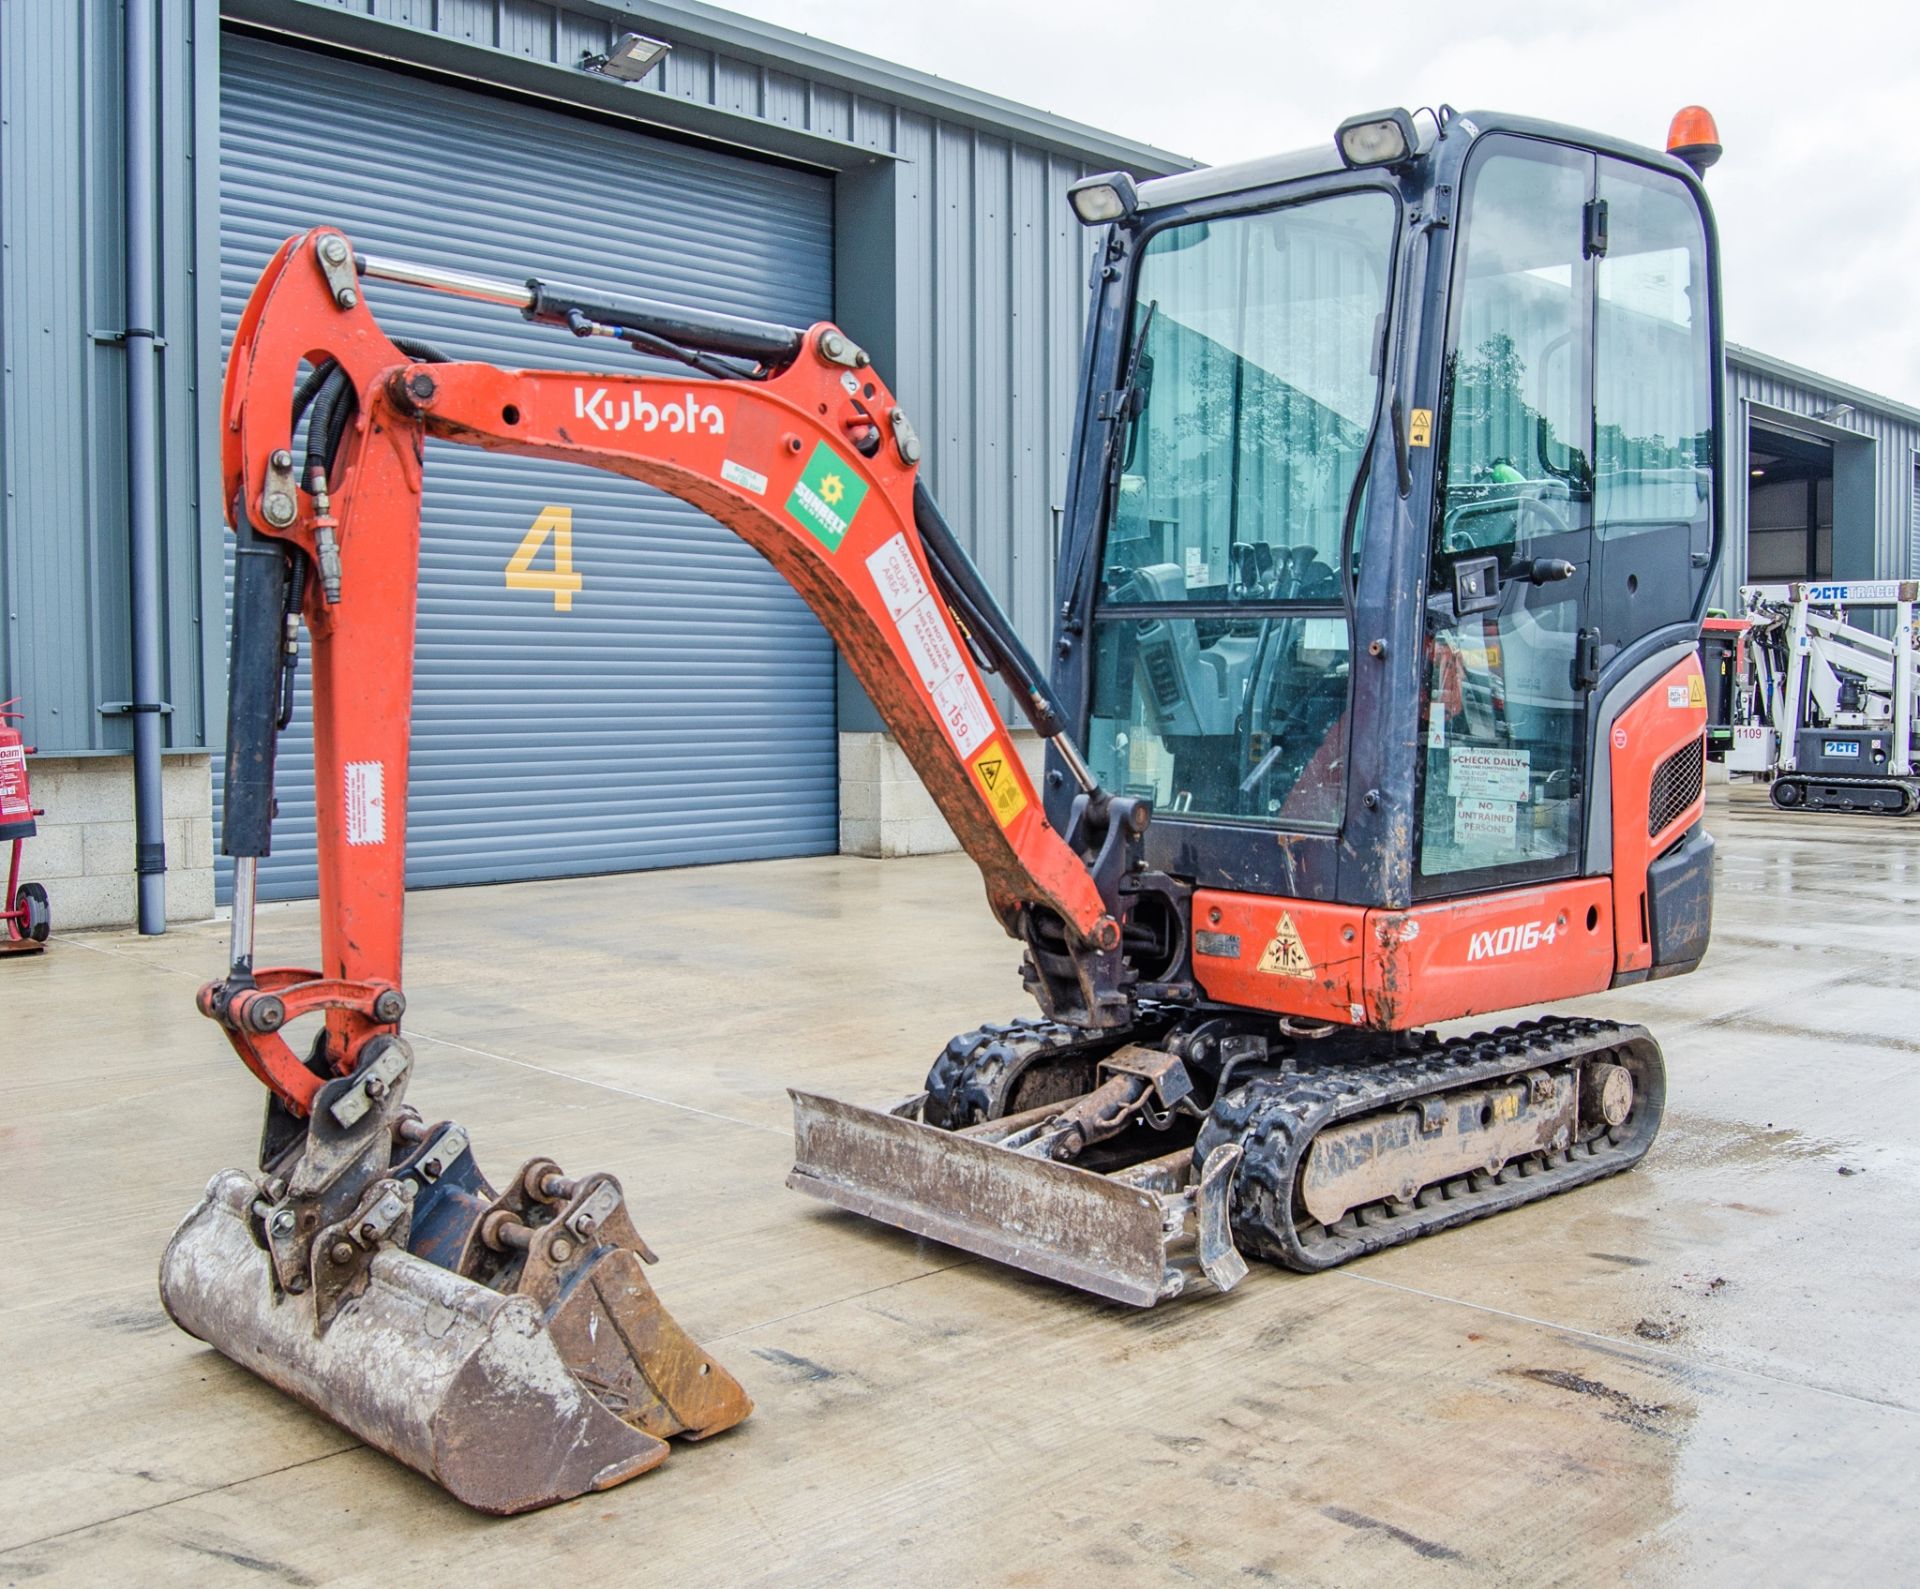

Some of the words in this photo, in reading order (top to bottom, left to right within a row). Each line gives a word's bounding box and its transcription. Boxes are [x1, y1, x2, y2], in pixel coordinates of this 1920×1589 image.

[574, 387, 725, 435] Kubota
[794, 481, 848, 535] SUNBELT
[505, 505, 582, 611] 4
[899, 545, 921, 587] DANGER
[882, 567, 900, 598] AREA
[889, 556, 911, 594] CRUSH
[1822, 586, 1848, 600] CTE
[1848, 584, 1900, 599] TRACC
[915, 606, 927, 627] THIS
[925, 626, 950, 674] EXCAVATOR
[926, 611, 935, 625] DO
[932, 625, 944, 642] NOT
[942, 643, 952, 658] USE
[923, 642, 940, 669] CRANE
[948, 704, 969, 737] 159
[1736, 728, 1762, 739] 1109
[0, 750, 20, 759] oam
[1458, 755, 1490, 765] CHECK
[1493, 758, 1522, 767] DAILY
[1836, 743, 1858, 753] CTE
[1458, 811, 1514, 824] UNTRAINED
[1479, 802, 1494, 810] NO
[1464, 822, 1506, 833] PERSONS
[1467, 920, 1557, 962] KX016-4
